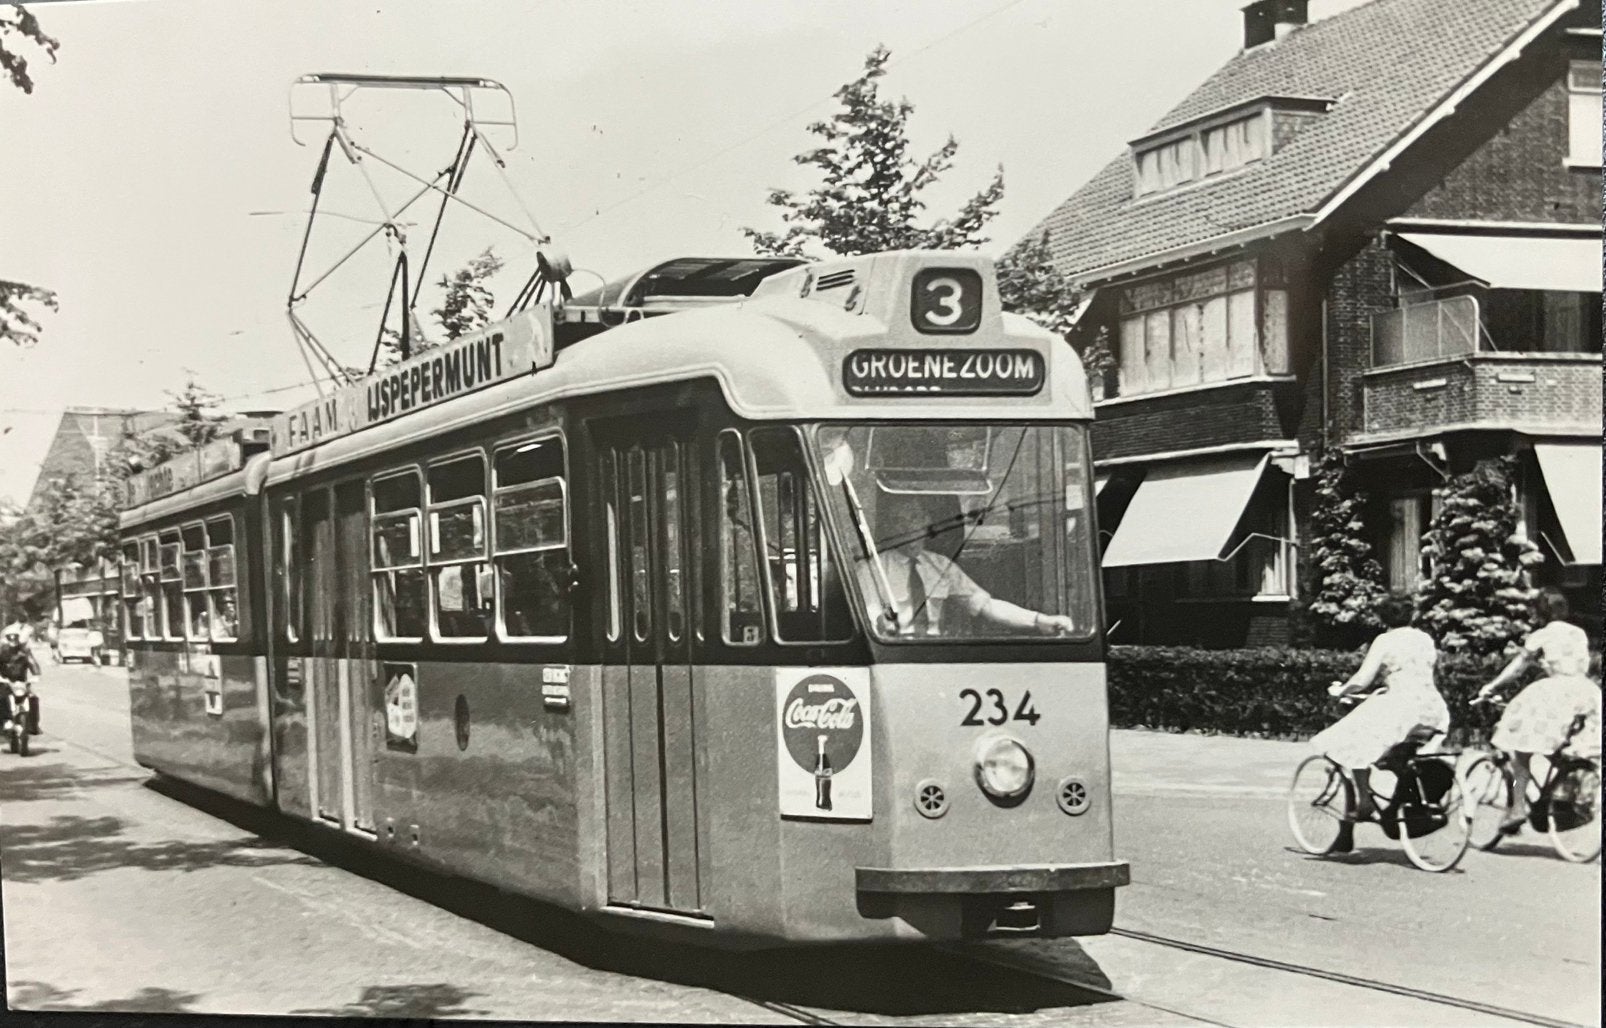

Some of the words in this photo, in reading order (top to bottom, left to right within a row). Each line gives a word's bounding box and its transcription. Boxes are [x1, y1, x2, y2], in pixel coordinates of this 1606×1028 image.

[924, 277, 963, 326] 3
[288, 398, 338, 447] FAAM
[367, 332, 504, 423] IJSPEPERMUNT
[785, 697, 857, 729] Coca-Cola
[958, 688, 1042, 727] 234
